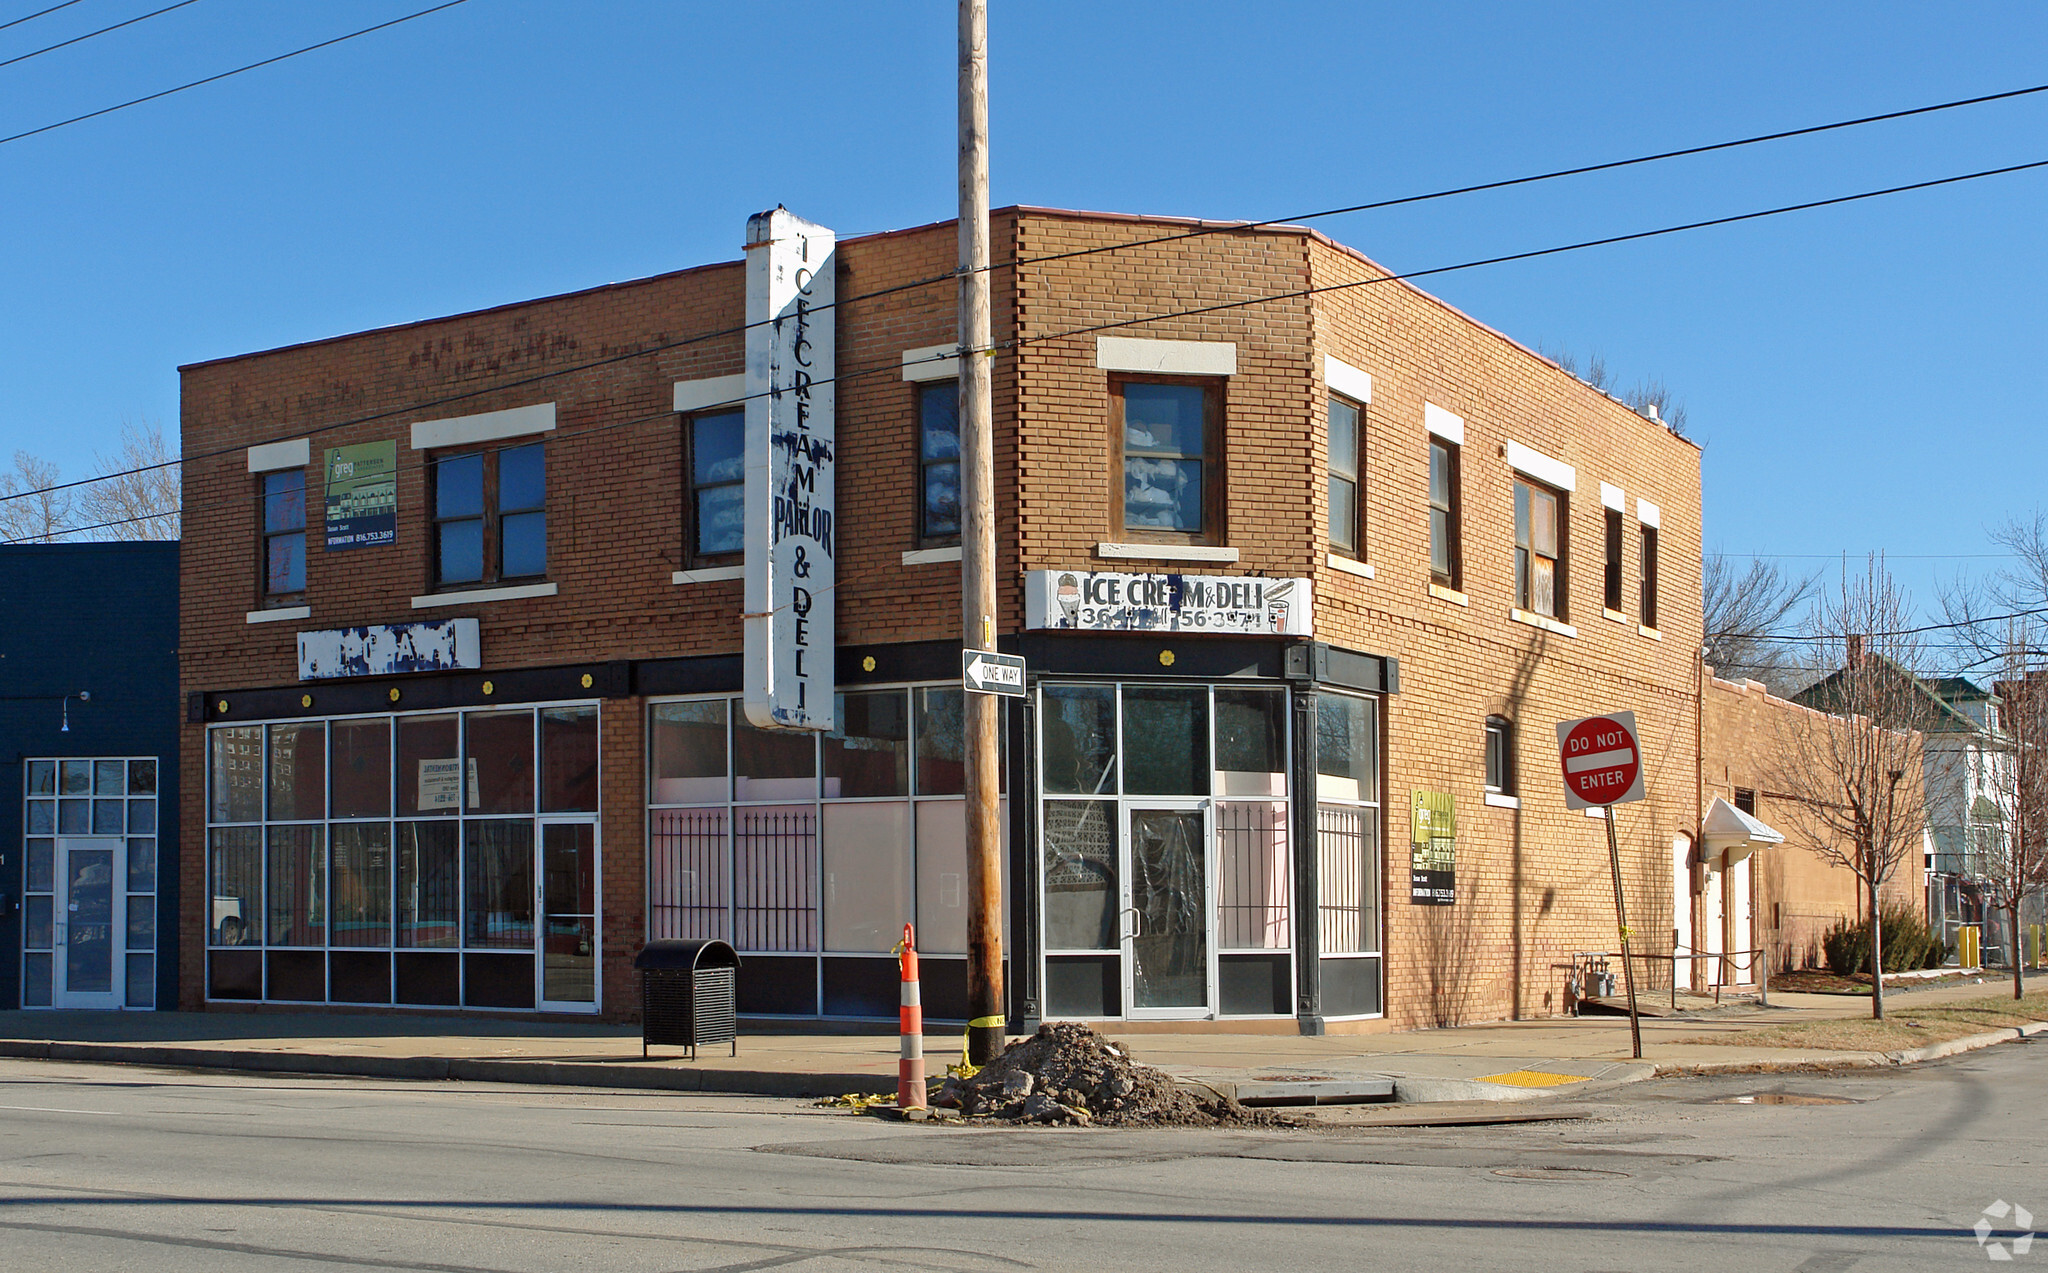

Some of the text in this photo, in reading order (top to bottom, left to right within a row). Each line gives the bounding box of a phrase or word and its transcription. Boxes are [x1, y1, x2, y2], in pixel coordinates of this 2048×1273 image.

[335, 462, 354, 478] greg
[774, 495, 832, 560] PARLOR
[1083, 578, 1120, 606] ICE
[793, 545, 812, 711] & DELI
[983, 665, 1018, 683] ONE WAY
[1570, 731, 1624, 752] DO NOT
[1580, 771, 1624, 790] ENTER
